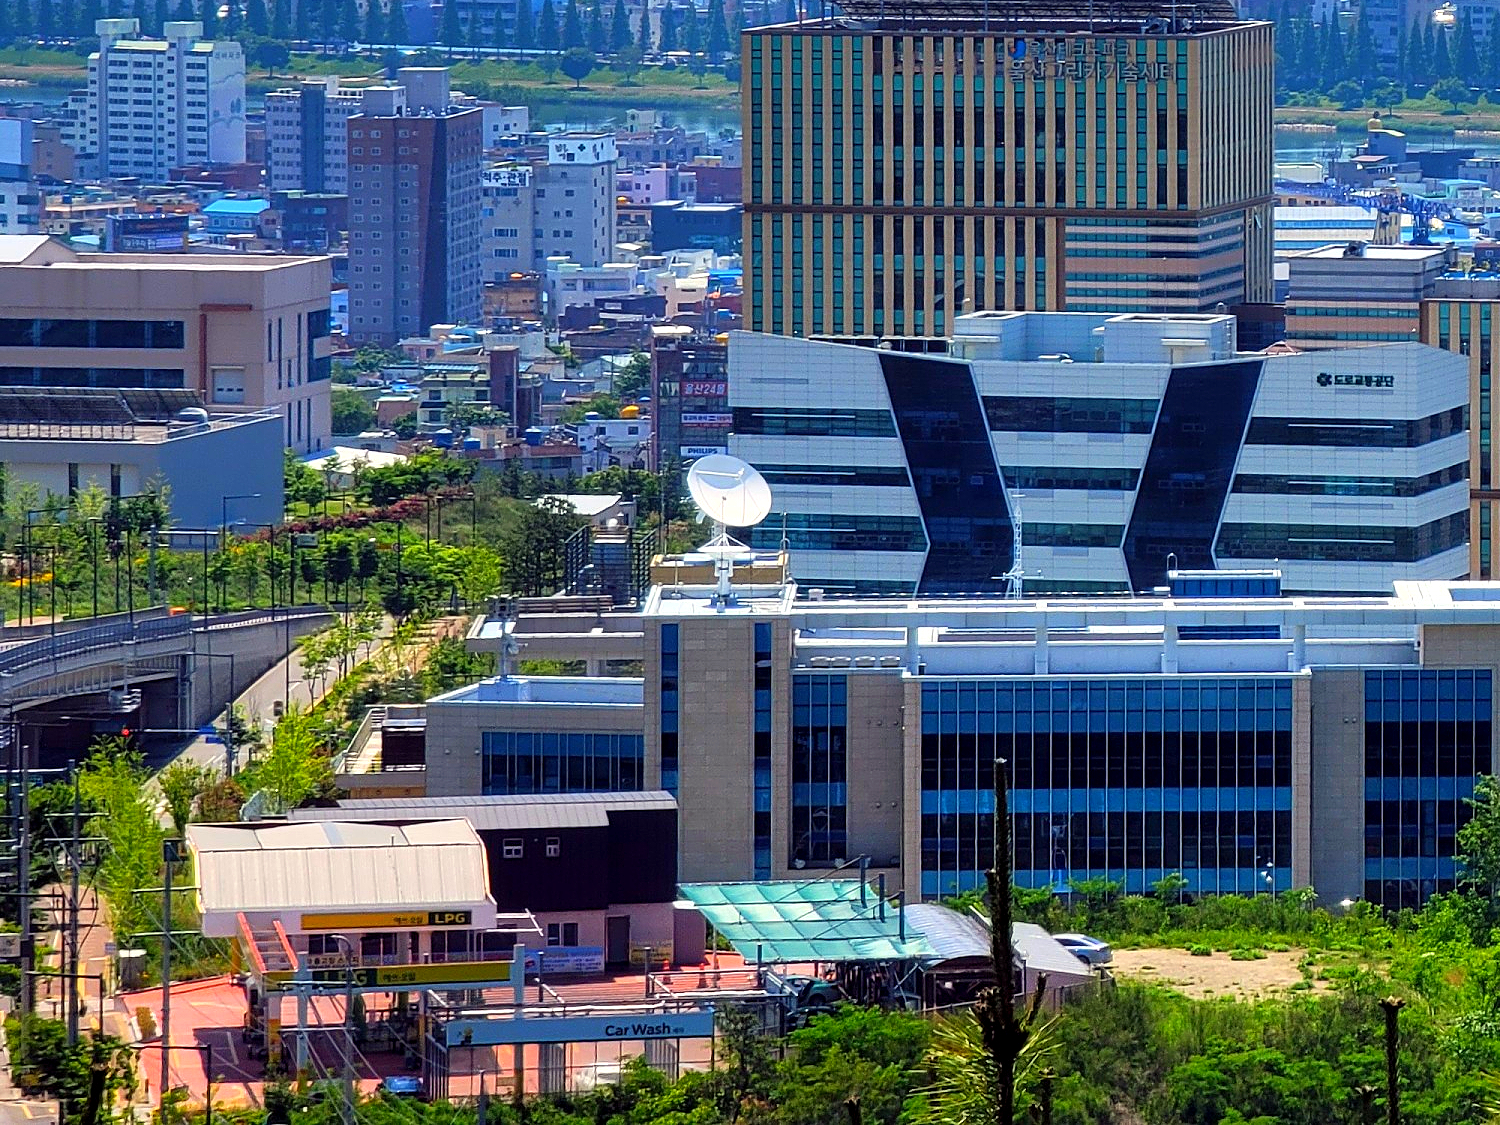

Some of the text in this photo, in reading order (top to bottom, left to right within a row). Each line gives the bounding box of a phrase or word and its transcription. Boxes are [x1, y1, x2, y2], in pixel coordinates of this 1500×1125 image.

[1028, 41, 1131, 57] 울산테크노파크
[1008, 61, 1177, 83] 울산그린카기술센터
[1334, 374, 1395, 388] 도로교통공단
[687, 447, 718, 455] PHILIPS
[434, 913, 466, 924] LPG
[605, 1025, 629, 1036] Car
[632, 1022, 671, 1036] Wash
